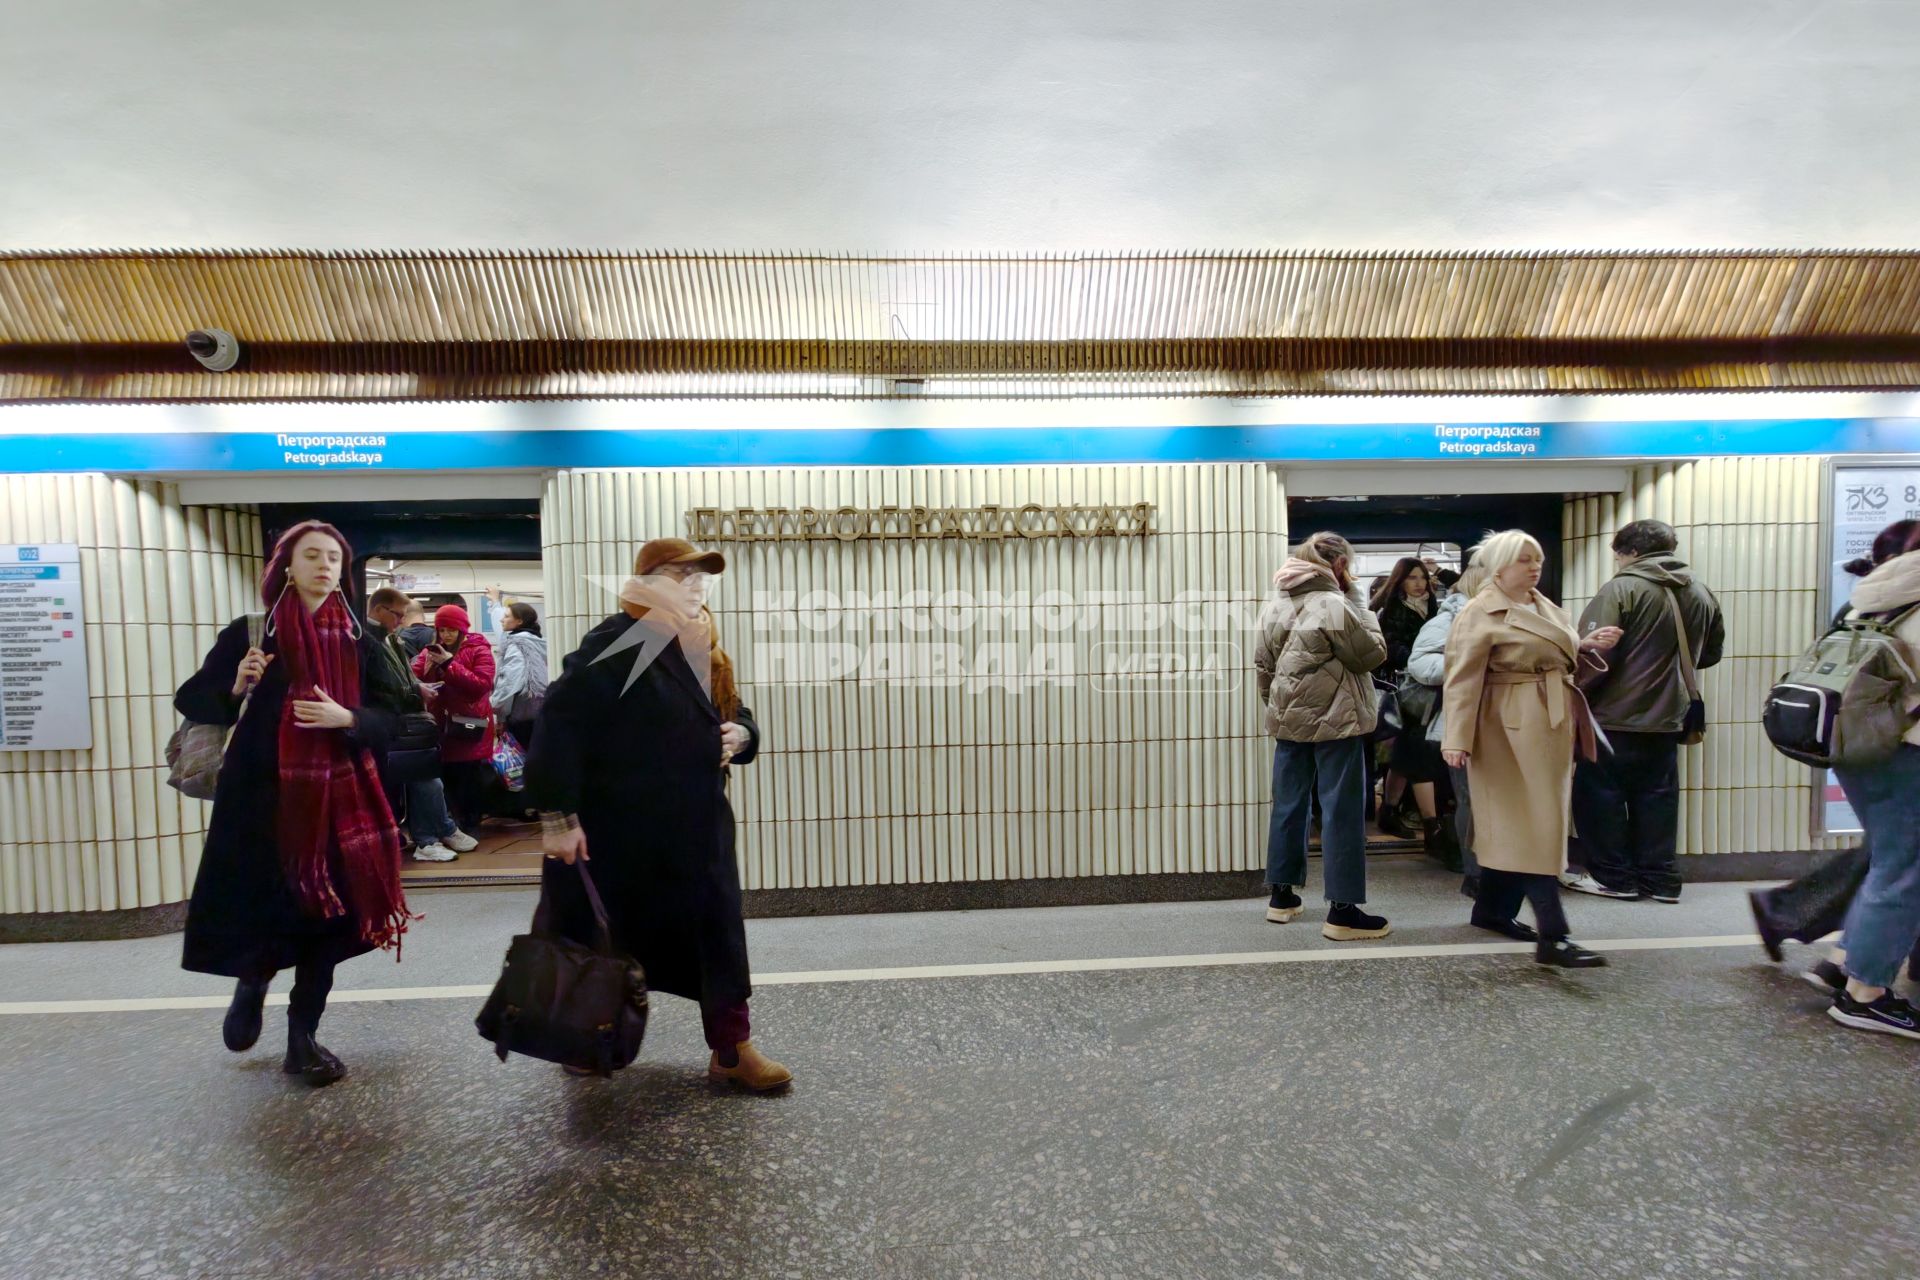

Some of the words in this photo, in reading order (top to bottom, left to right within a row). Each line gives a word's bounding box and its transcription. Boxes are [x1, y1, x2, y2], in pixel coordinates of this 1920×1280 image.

[1435, 425, 1540, 439] Петроградская
[277, 433, 386, 449] Петроградская
[1439, 441, 1535, 455] Petrogradskaya
[284, 451, 382, 466] Petrogradskaya
[691, 501, 1153, 543] ПЕТРОГРАДСКАЯ
